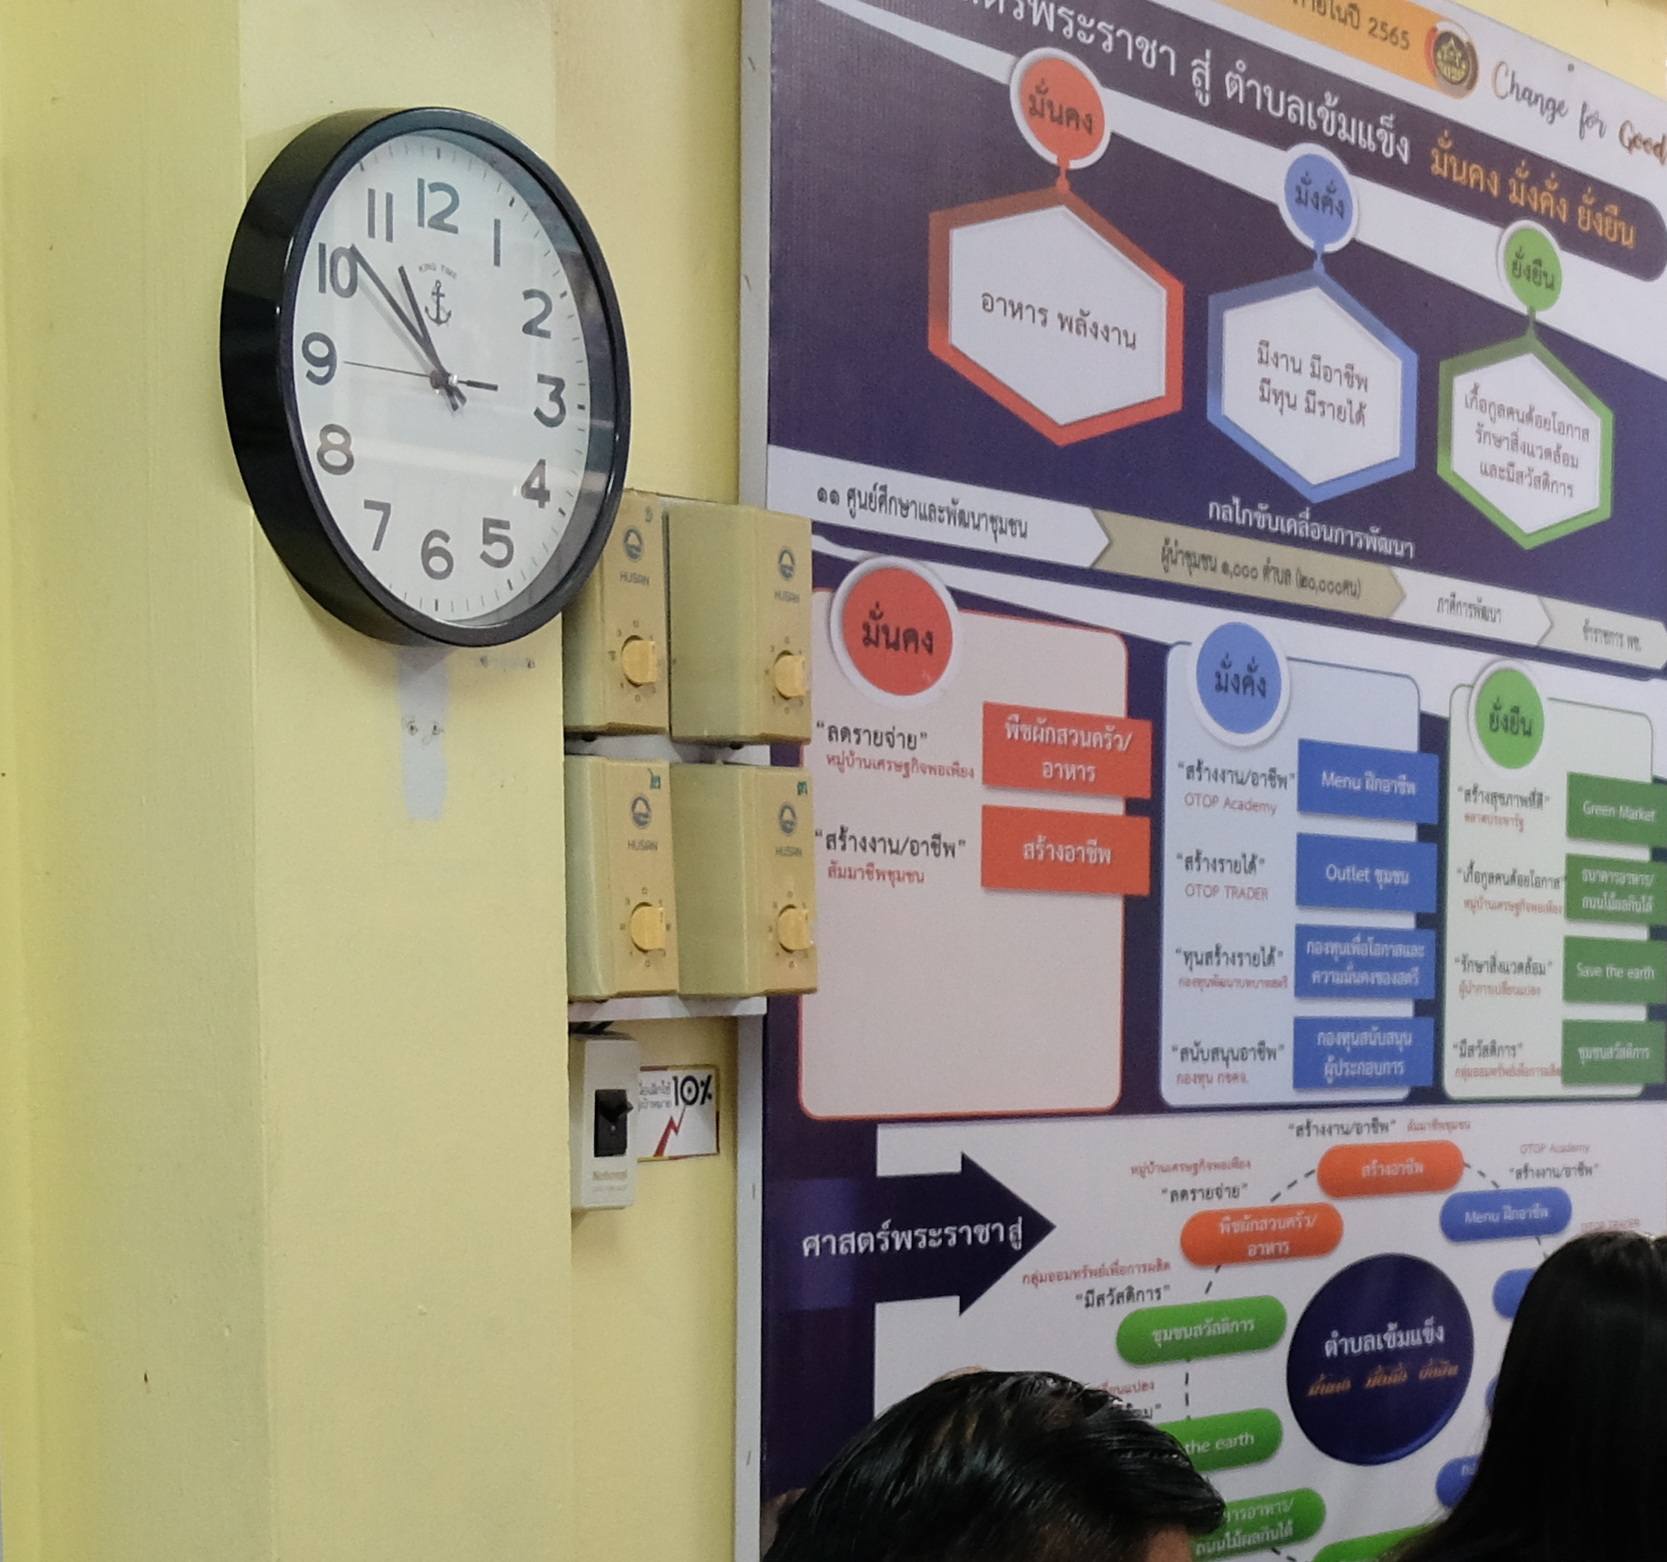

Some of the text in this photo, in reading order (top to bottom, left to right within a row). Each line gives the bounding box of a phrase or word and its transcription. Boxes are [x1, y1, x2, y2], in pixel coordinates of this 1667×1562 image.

[1367, 17, 1410, 50] 2565
[1027, 78, 1094, 136] มั่นคง
[1492, 61, 1568, 125] Change
[1578, 101, 1608, 141] for
[1190, 49, 1212, 107] สู่
[1225, 62, 1411, 165] ตำบลเข้มแข็ง
[1430, 129, 1500, 198] มั่นคง
[1507, 159, 1568, 225] มั่งคั่ง
[1577, 187, 1637, 250] ยั่งยืน
[367, 187, 394, 243] 11
[418, 177, 460, 235] 12
[1294, 175, 1346, 221] มั่งคั่ง
[493, 218, 502, 267] 1
[317, 242, 359, 299] 10
[1510, 246, 1556, 293] ยั่งยืน
[522, 288, 552, 340] 2
[981, 292, 1137, 351] อาหาร พลังงาน
[301, 331, 338, 386] 9
[1257, 339, 1369, 393] มีงาน มีอาชีพ
[533, 373, 567, 428] 3
[1258, 379, 1366, 428] มีทุน มีรายได้
[316, 423, 355, 476] 8
[520, 458, 552, 509] 4
[363, 499, 392, 552] 7
[847, 481, 1029, 544] ศูนย์ศึกษาและพัฒนาชุมชน
[1208, 496, 1416, 560] กลไกขับเคลื่อนการพัฒนา
[420, 528, 455, 581] 6
[479, 516, 515, 569] 5
[862, 601, 934, 656] มั่นคง
[1214, 652, 1267, 699] มั่งคั่ง
[1489, 697, 1532, 737] ยั่งยืน
[1042, 759, 1097, 783] อาหาร
[1321, 770, 1363, 792] Menu
[1183, 792, 1278, 817] OTOP Academy
[1022, 833, 1113, 866] สร้างอาชีพ
[1325, 863, 1371, 885] Outlet
[1184, 883, 1221, 899] OTOP
[1576, 961, 1602, 978] Save
[672, 1074, 713, 1107] 10%
[1464, 1210, 1499, 1224] Menu
[1247, 1240, 1290, 1258] อาหาร
[1324, 1315, 1446, 1360] ตำบลเข้มแข็ง
[1215, 1431, 1255, 1451] earth
